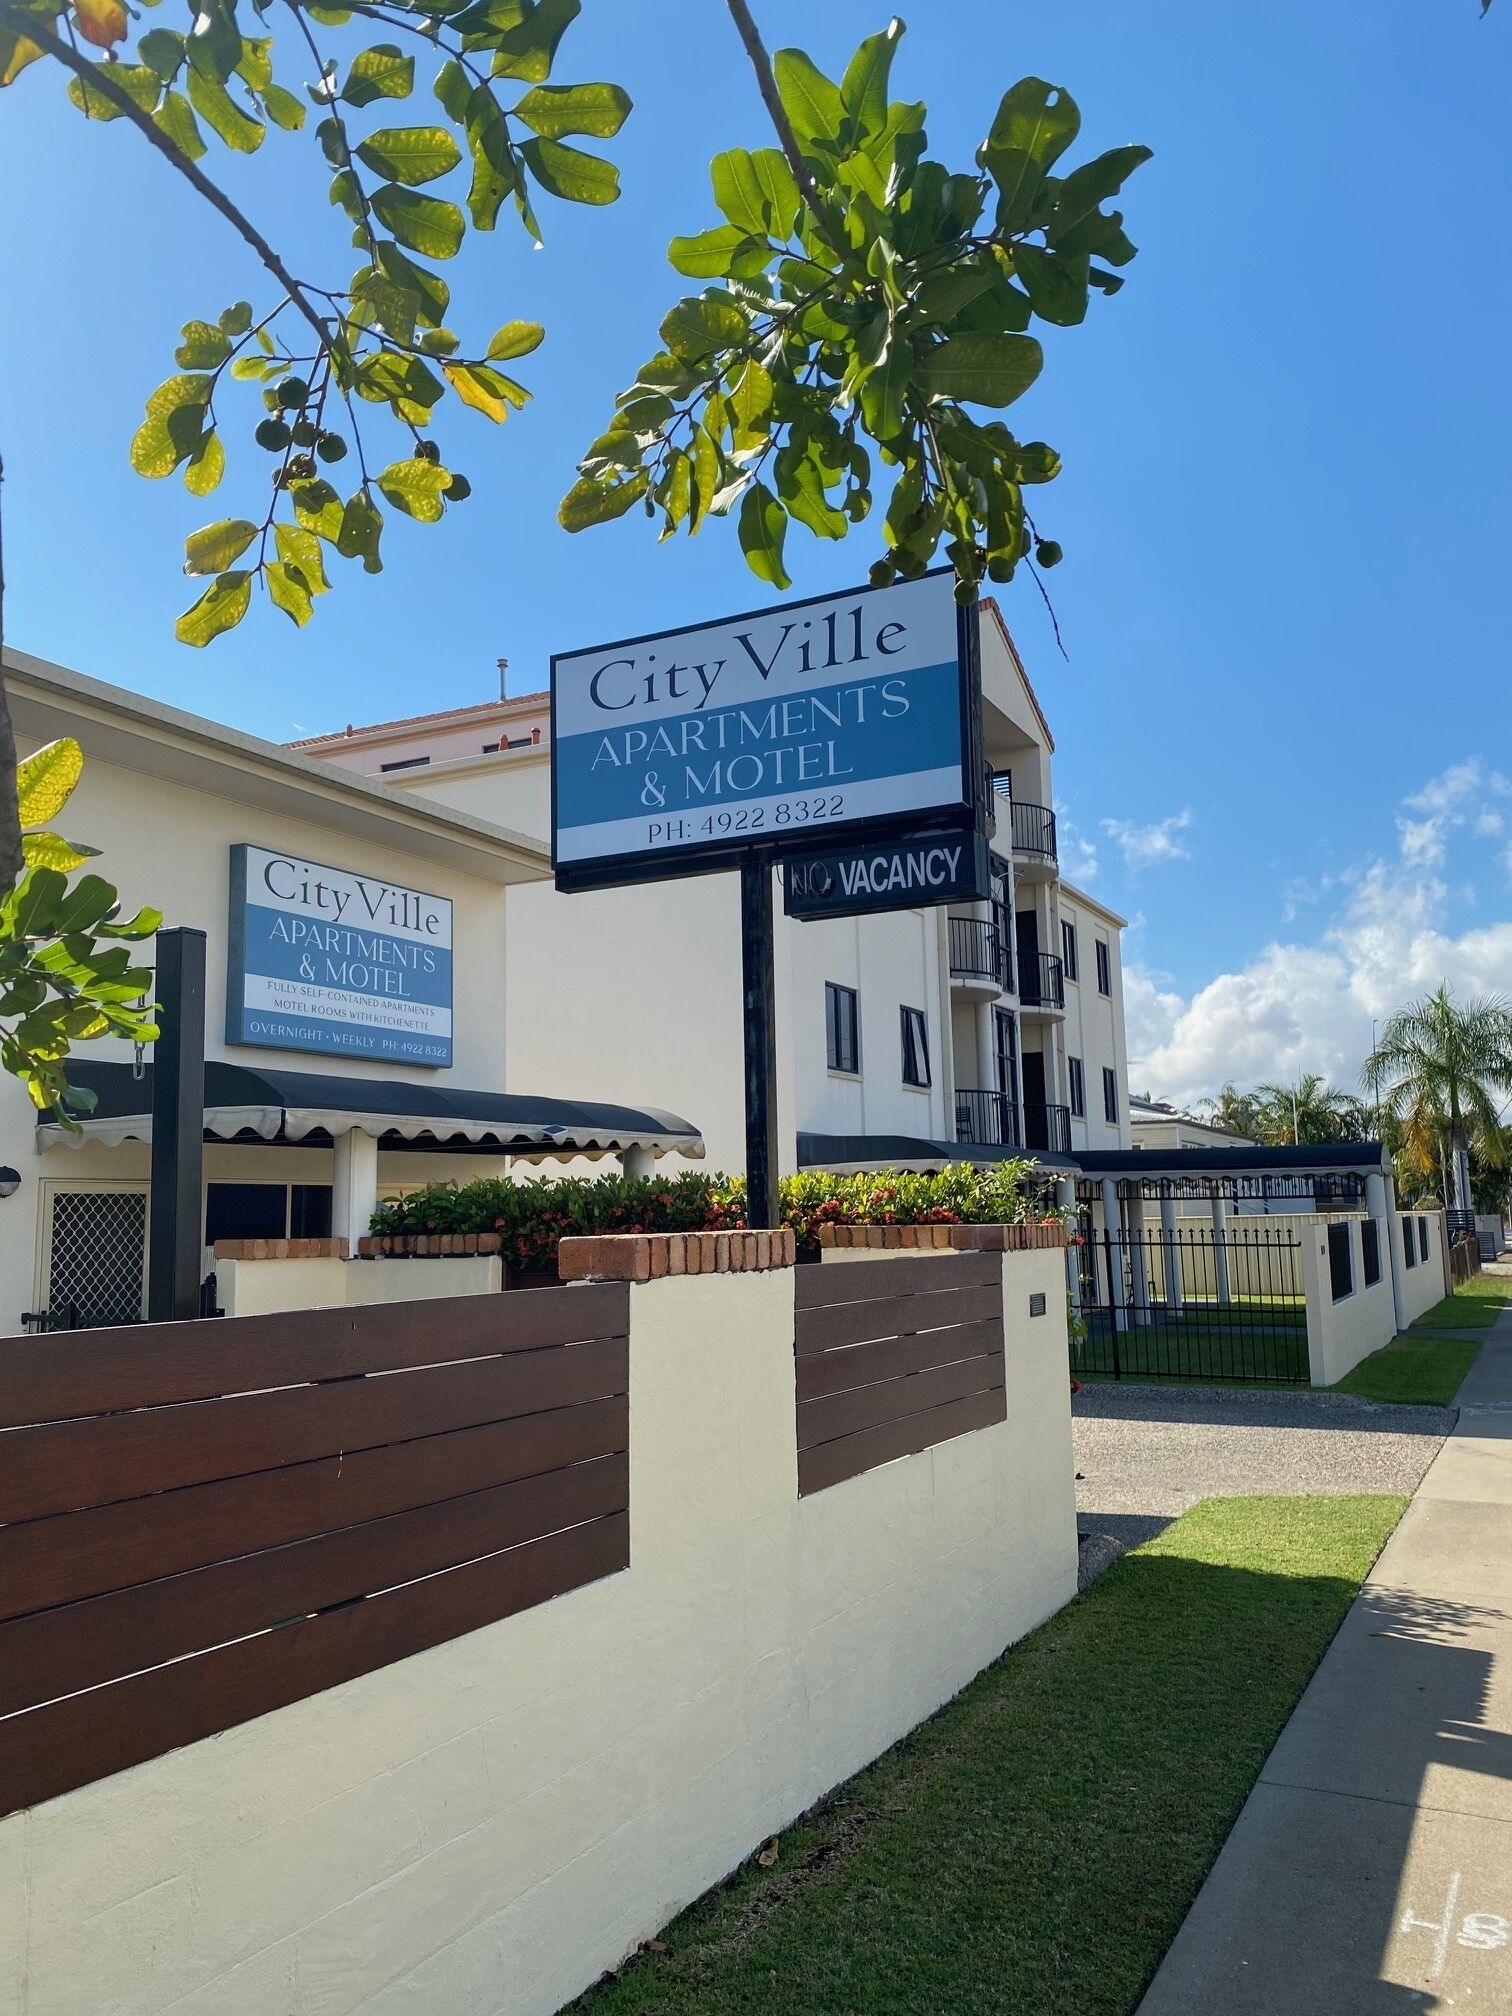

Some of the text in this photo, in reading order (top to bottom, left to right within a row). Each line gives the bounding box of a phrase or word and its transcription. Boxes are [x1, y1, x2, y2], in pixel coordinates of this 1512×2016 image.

[590, 680, 910, 771] APARTMENTS
[640, 739, 854, 807] & MOTEL
[648, 794, 844, 843] PH: 4922 8322
[840, 846, 962, 897] VACANCY
[269, 917, 436, 973] APARTMENTS
[267, 980, 436, 1017] FULLY SELF-CONTAINED APARTMENTS
[299, 952, 411, 997] & MOTEL
[273, 998, 430, 1031] MOTEL ROOMS WITH KITCHENETTE
[250, 1021, 448, 1058] OVERNIGHT WEEKLY PH: 4922 8322
